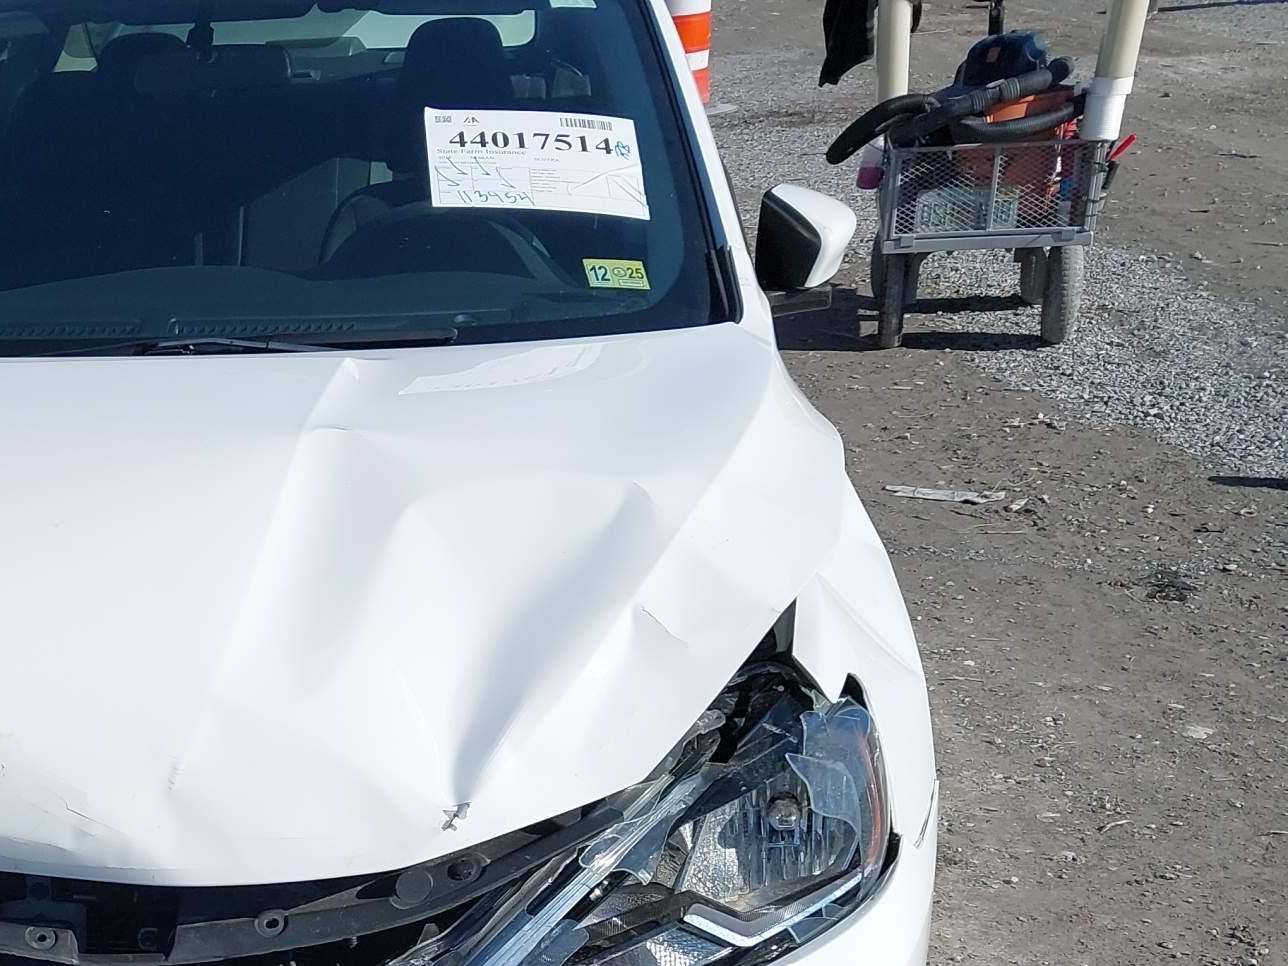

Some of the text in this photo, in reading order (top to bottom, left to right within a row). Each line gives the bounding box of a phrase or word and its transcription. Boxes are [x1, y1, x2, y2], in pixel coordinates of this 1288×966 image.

[449, 130, 614, 154] 44017514
[590, 265, 644, 281] 12 25
